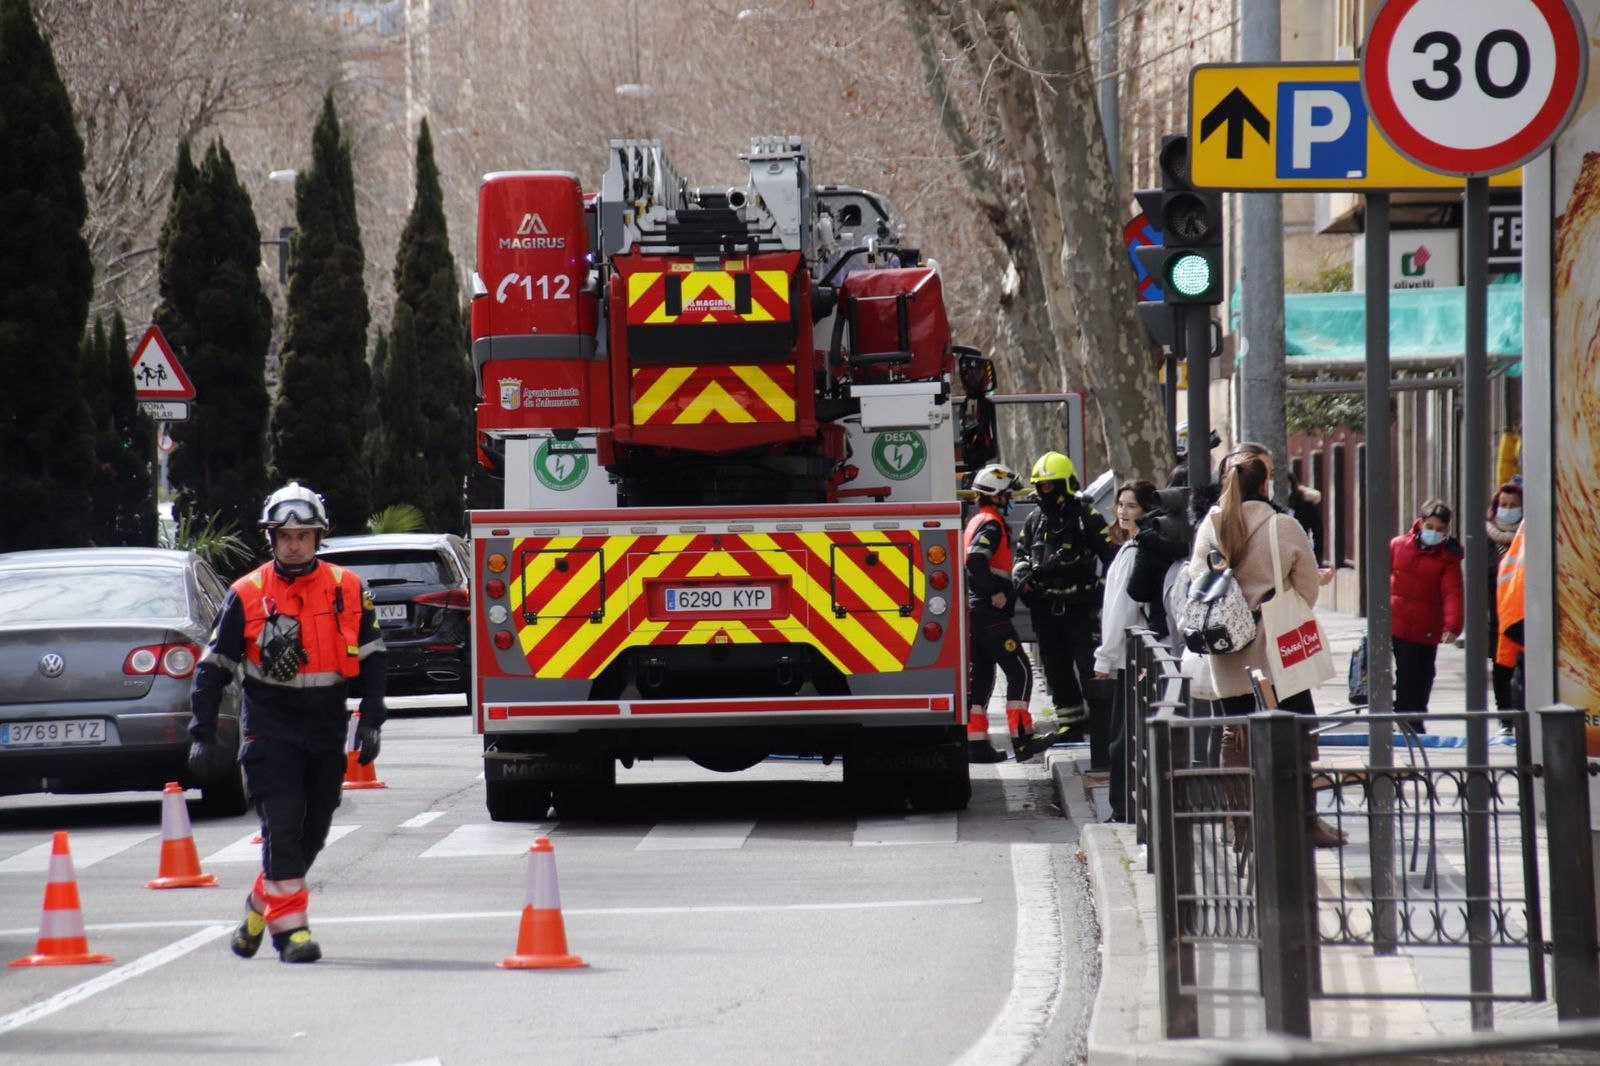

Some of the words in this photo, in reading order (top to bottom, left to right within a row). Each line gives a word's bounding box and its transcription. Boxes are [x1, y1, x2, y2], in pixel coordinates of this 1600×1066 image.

[1412, 28, 1531, 101] 30
[1292, 89, 1352, 169] P
[498, 237, 566, 250] MAGIRUS
[519, 274, 571, 300] 112
[1393, 278, 1435, 289] olivetti
[523, 387, 580, 398] Ayuntamiento
[523, 398, 534, 407] de
[535, 398, 580, 407] Salamanca
[884, 433, 913, 442] DESA
[679, 590, 722, 608] 6290
[733, 589, 766, 607] KYP
[380, 604, 404, 617] KVJ
[12, 724, 59, 742] 3769
[64, 722, 100, 739] FYZ
